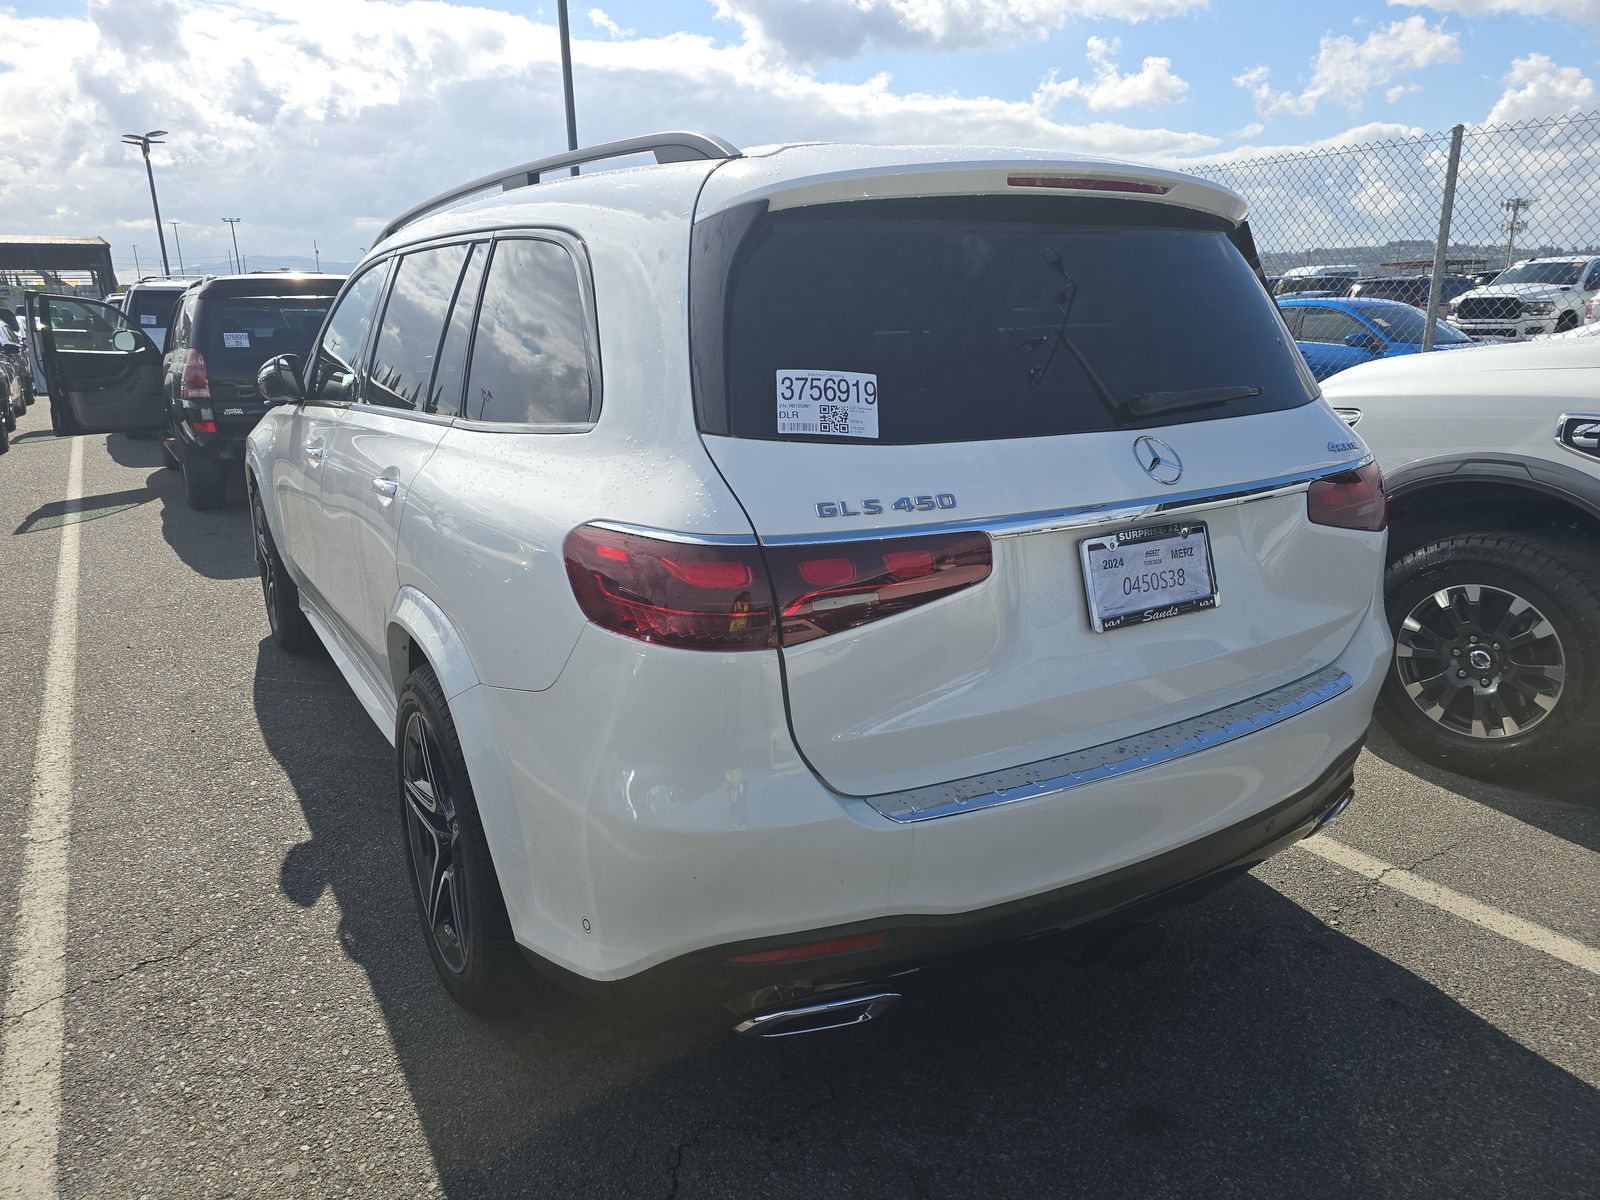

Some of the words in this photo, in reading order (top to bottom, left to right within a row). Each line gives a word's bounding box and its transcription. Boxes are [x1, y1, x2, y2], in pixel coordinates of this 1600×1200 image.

[780, 376, 877, 405] 3756919
[778, 411, 799, 419] DLR
[814, 498, 884, 518] GLS
[891, 492, 957, 513] 450
[1170, 547, 1194, 560] MERZ
[1102, 557, 1125, 570] 2024
[1122, 568, 1186, 596] 0450S38
[1142, 606, 1179, 623] Sands
